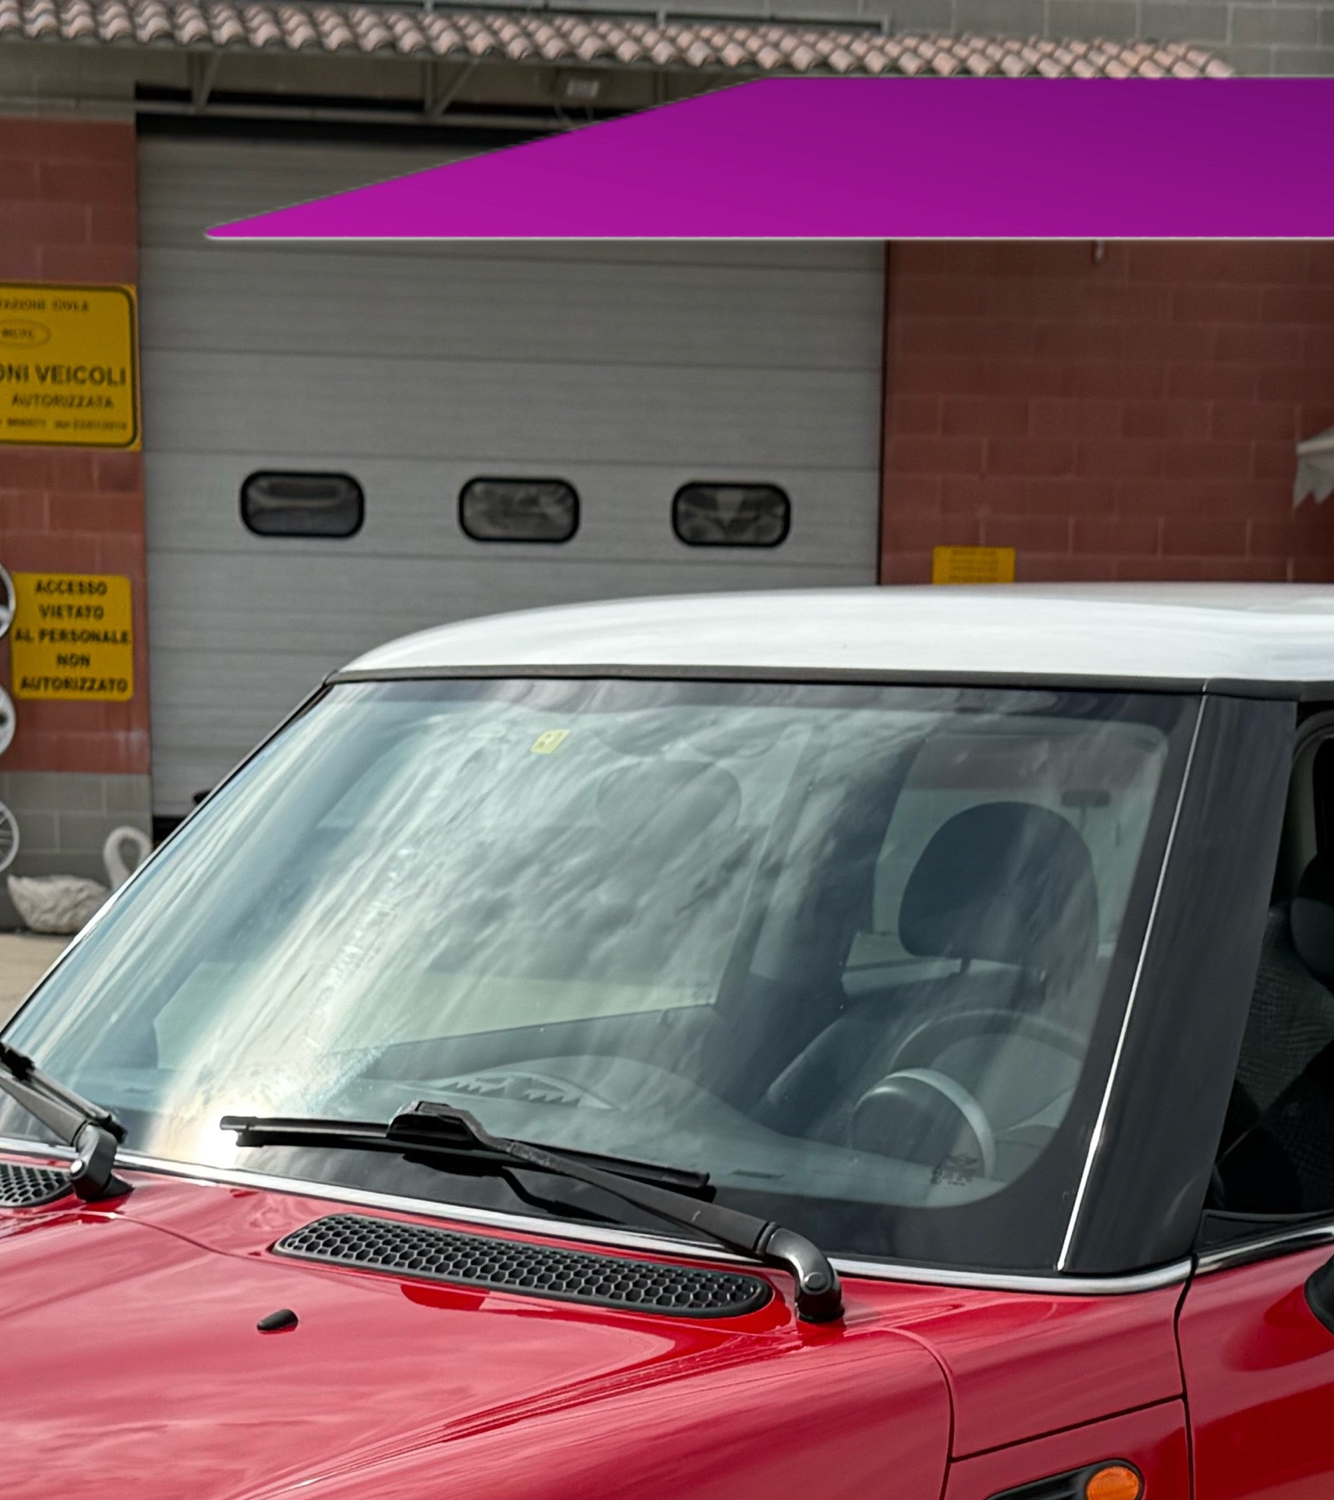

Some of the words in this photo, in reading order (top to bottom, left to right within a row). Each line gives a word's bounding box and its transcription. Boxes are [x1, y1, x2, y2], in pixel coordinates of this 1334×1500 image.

[35, 365, 127, 387] VEICOLI
[11, 393, 114, 410] AUTORIZZATA
[35, 581, 108, 596] ACCESSO
[38, 604, 105, 620] VIETATO
[15, 627, 36, 643] AL
[38, 628, 129, 644] PERSONALE
[56, 652, 92, 668] NON
[20, 675, 129, 693] AUTORIZZATO
